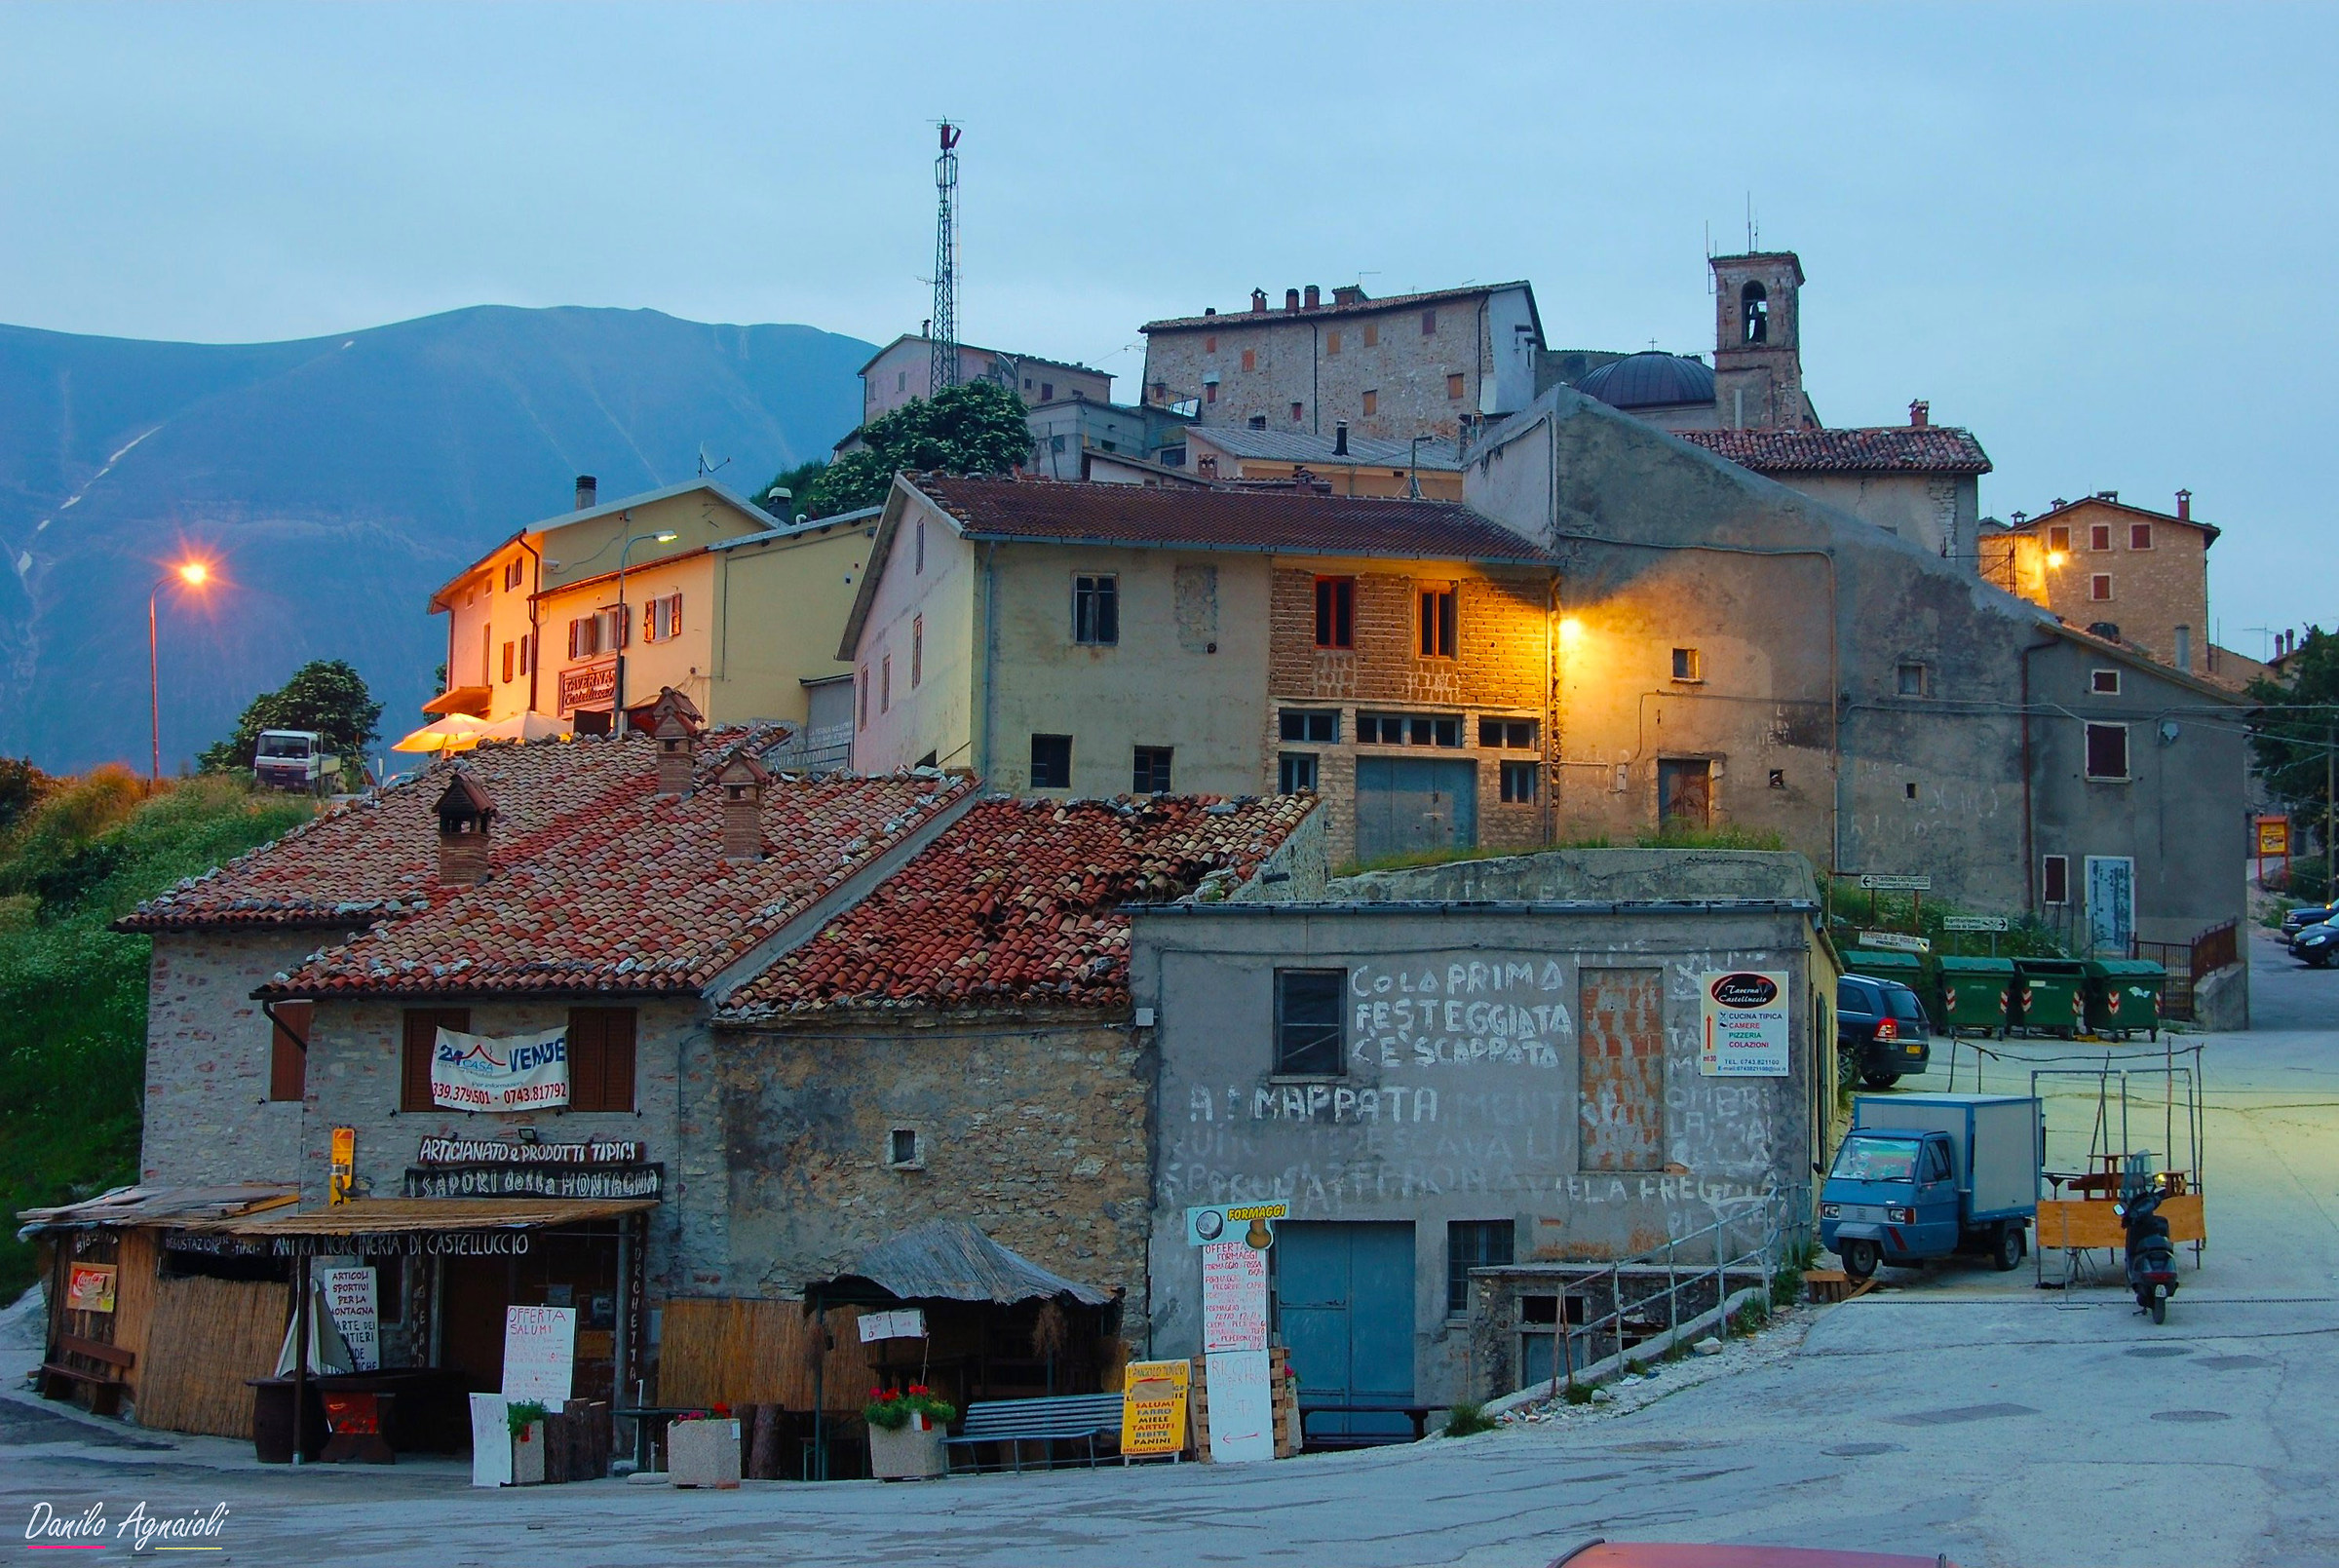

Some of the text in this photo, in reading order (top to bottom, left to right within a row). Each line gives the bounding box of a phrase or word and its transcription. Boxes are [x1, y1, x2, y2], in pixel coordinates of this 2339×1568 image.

[1446, 960, 1563, 995] PRIMA
[1725, 984, 1759, 994] Taverna
[1718, 994, 1767, 1003] Castelluccio
[462, 1059, 493, 1072] CASA
[509, 1038, 565, 1072] VENDE
[504, 1082, 566, 1104] 0743.817792
[420, 1139, 507, 1162] ARTIGIANATO
[521, 1142, 585, 1163] PRODOTTI
[423, 1170, 497, 1197] SAPORI
[561, 1169, 658, 1196] MONTAGNA
[1227, 1205, 1286, 1221] FORMAGGI
[325, 1235, 401, 1256] NORCINERIA
[409, 1234, 421, 1256] DI
[427, 1234, 529, 1256] CASTELLUCCIO
[1217, 1250, 1258, 1261] FORMAGGI
[332, 1271, 368, 1281] ARTICOLI
[338, 1295, 366, 1306] PER LA
[509, 1307, 566, 1323] OFFERTA
[364, 1321, 376, 1330] DEI
[511, 1324, 552, 1336] SALUMI
[1135, 1400, 1174, 1409] SALUMI
[1135, 1430, 1168, 1438] BIBITE
